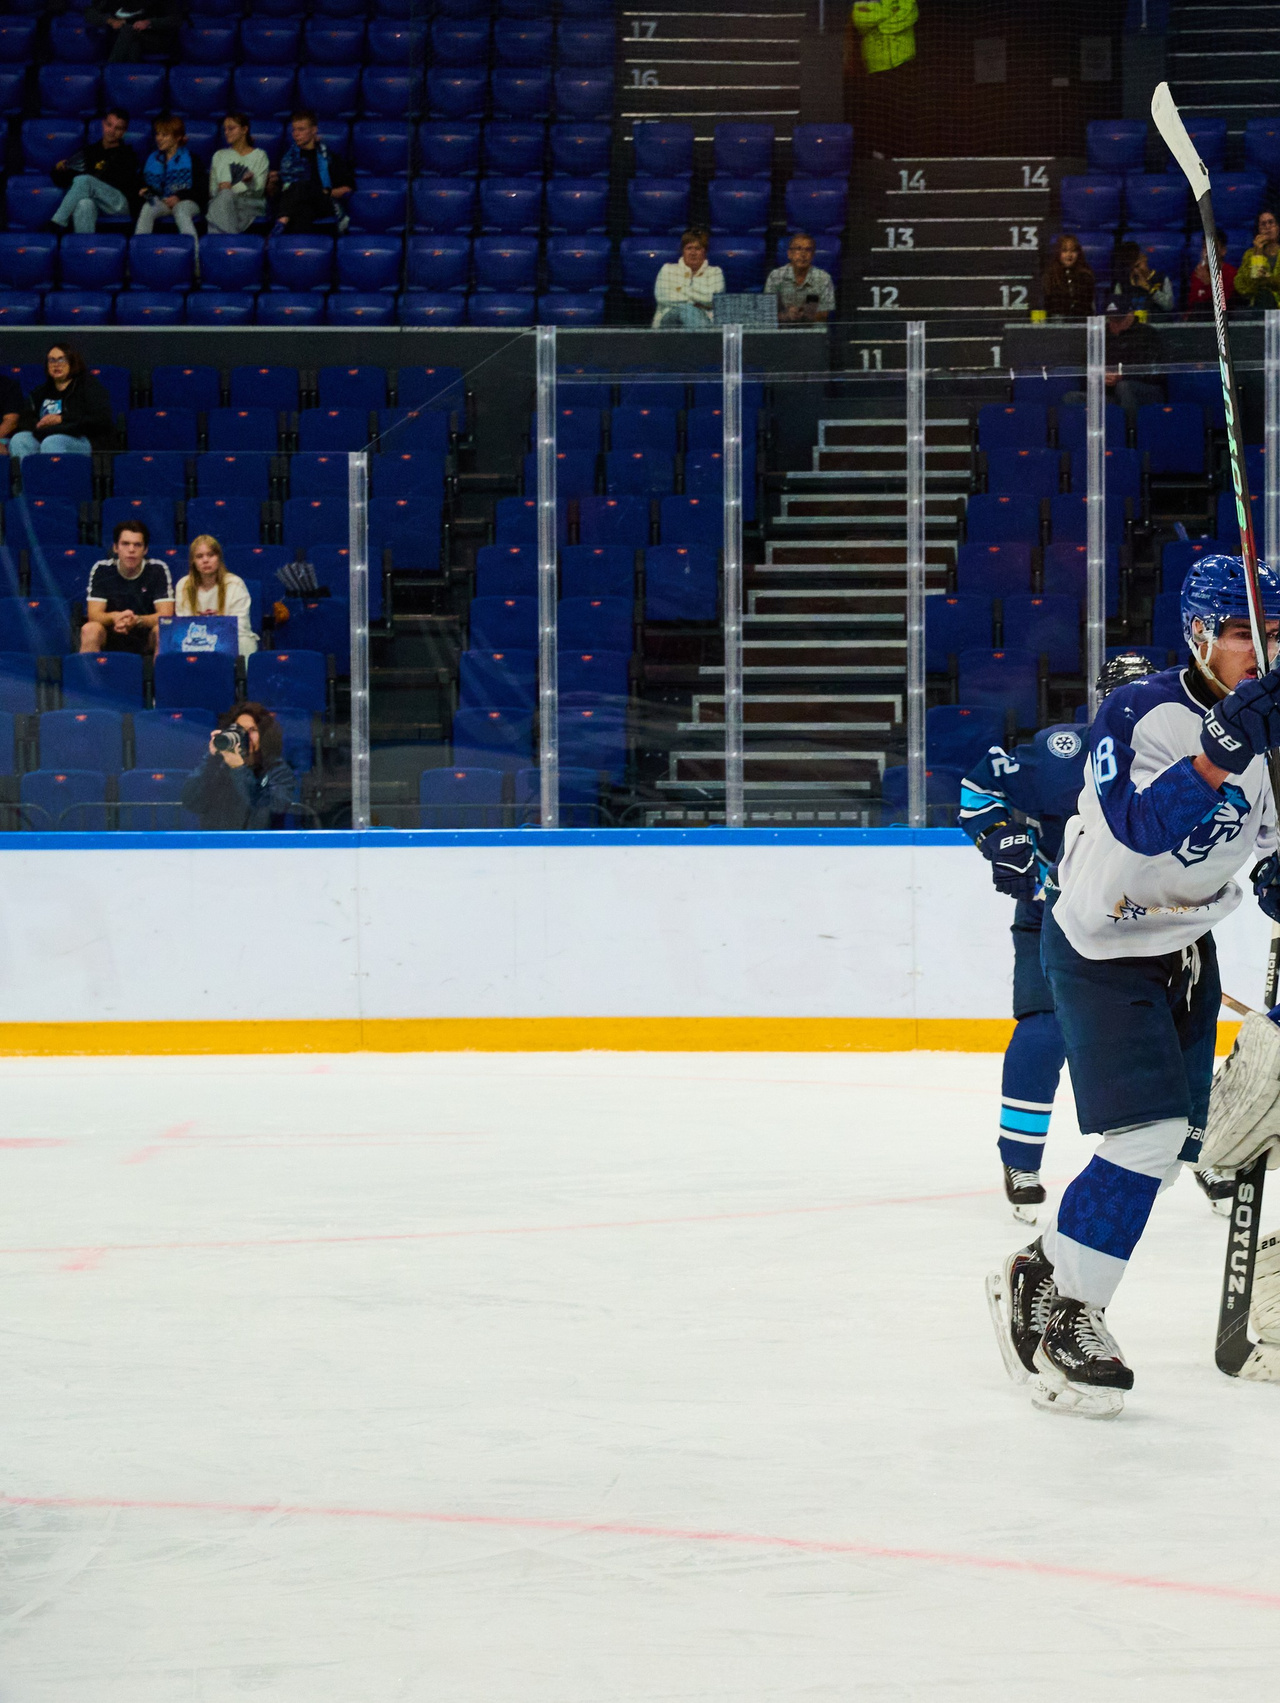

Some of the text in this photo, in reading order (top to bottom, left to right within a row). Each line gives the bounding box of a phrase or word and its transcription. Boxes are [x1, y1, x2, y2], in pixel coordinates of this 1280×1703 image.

[631, 21, 657, 38] 17
[631, 69, 658, 86] 16
[899, 170, 926, 190] 14
[1021, 166, 1049, 187] 14
[885, 227, 914, 249] 13
[1009, 226, 1038, 248] 13
[870, 286, 899, 308] 12
[1000, 285, 1028, 309] 12
[859, 349, 882, 370] 11
[1228, 1182, 1255, 1295] SOYUZ
